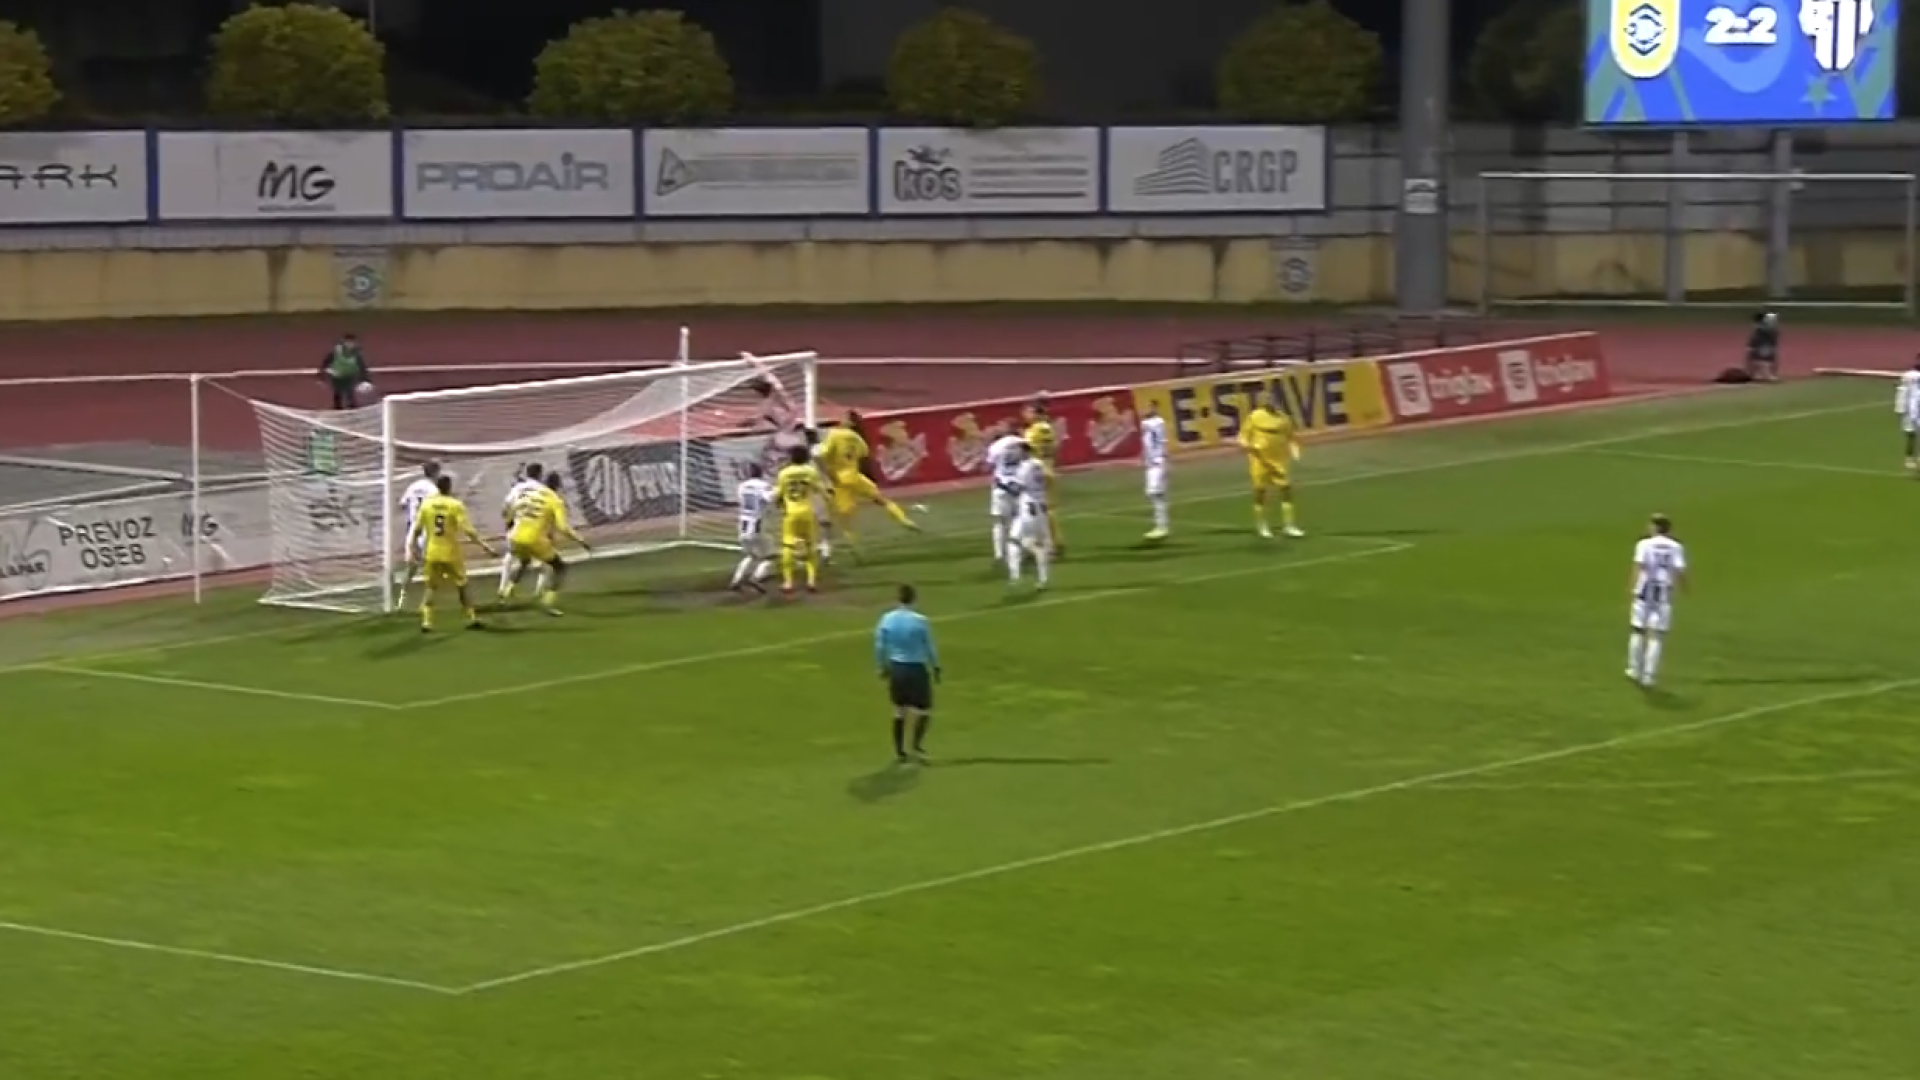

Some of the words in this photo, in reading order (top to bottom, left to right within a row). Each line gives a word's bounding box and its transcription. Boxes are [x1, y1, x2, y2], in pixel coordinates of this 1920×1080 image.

[257, 160, 335, 200] MG
[1214, 149, 1297, 194] CRGP
[58, 515, 155, 546] PREVOZ
[80, 543, 147, 570] OSEB
